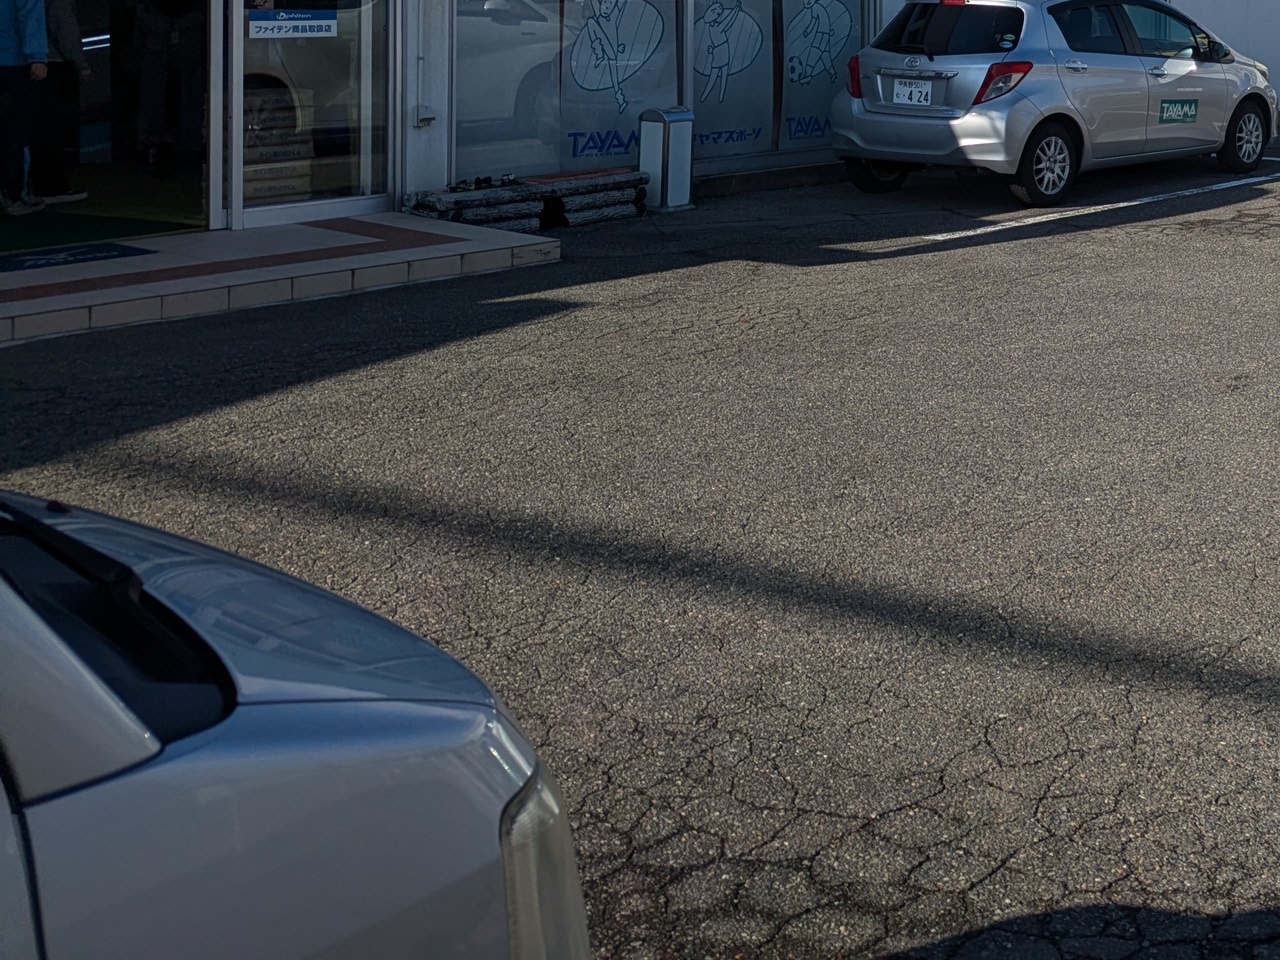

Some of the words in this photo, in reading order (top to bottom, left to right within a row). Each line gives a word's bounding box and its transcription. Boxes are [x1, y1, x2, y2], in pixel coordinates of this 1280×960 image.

[254, 24, 332, 34] ファイテン商品取扱店
[1162, 102, 1196, 119] TAYAMA
